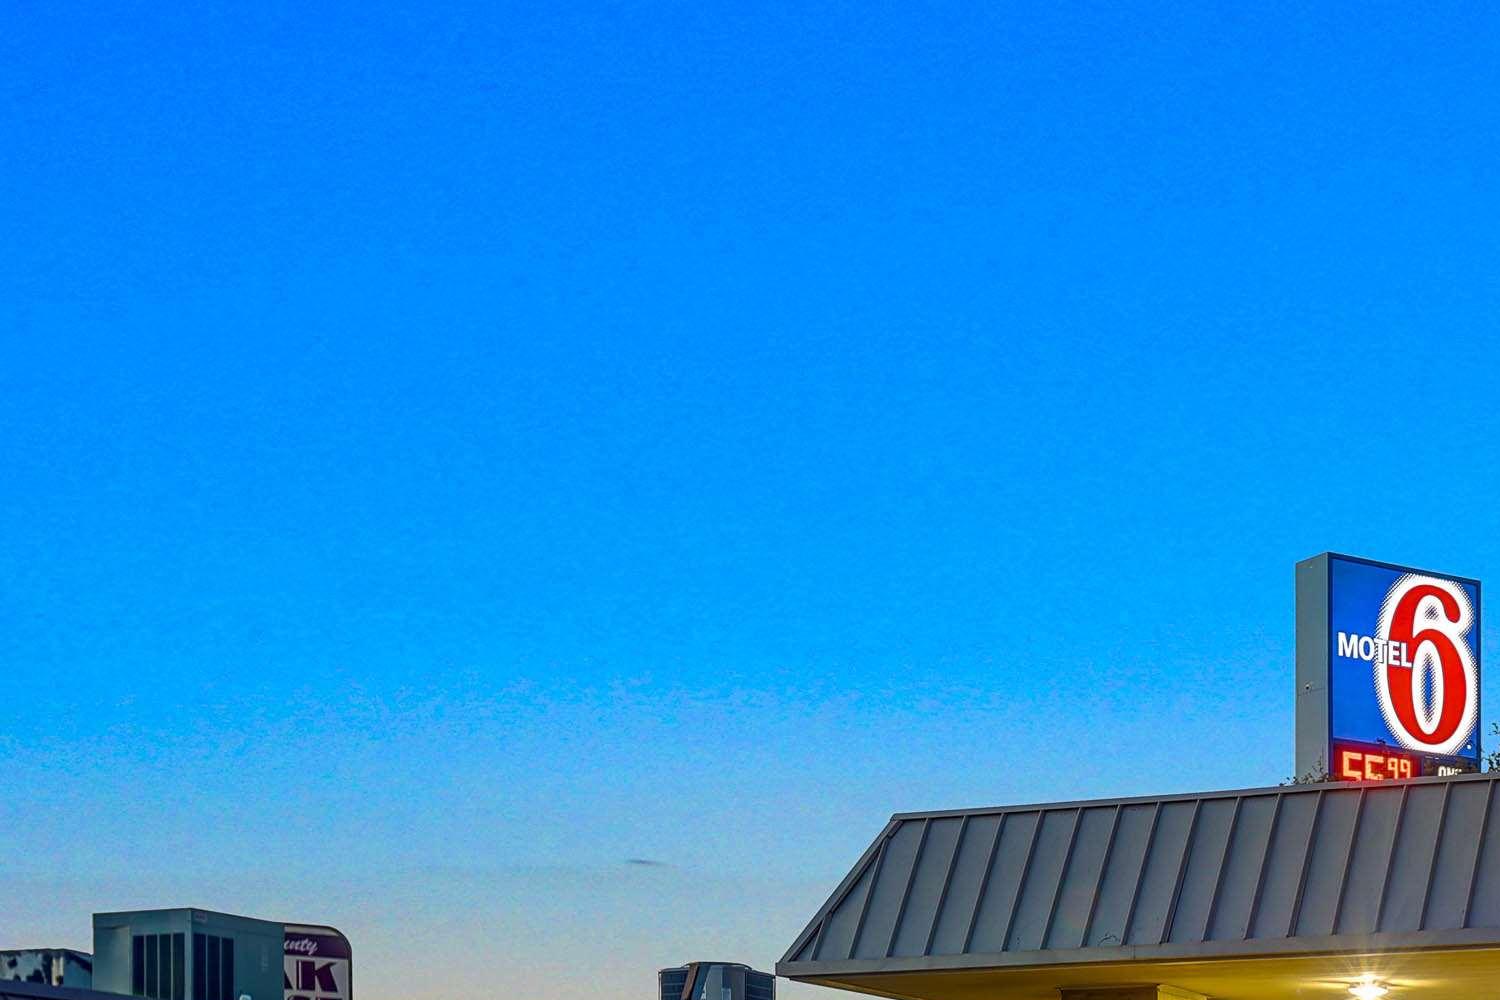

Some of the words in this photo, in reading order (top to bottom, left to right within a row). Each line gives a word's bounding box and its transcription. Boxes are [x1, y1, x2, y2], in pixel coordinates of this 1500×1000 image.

[1338, 632, 1412, 668] MOTEL
[1387, 584, 1467, 745] 6
[284, 960, 338, 993] K
